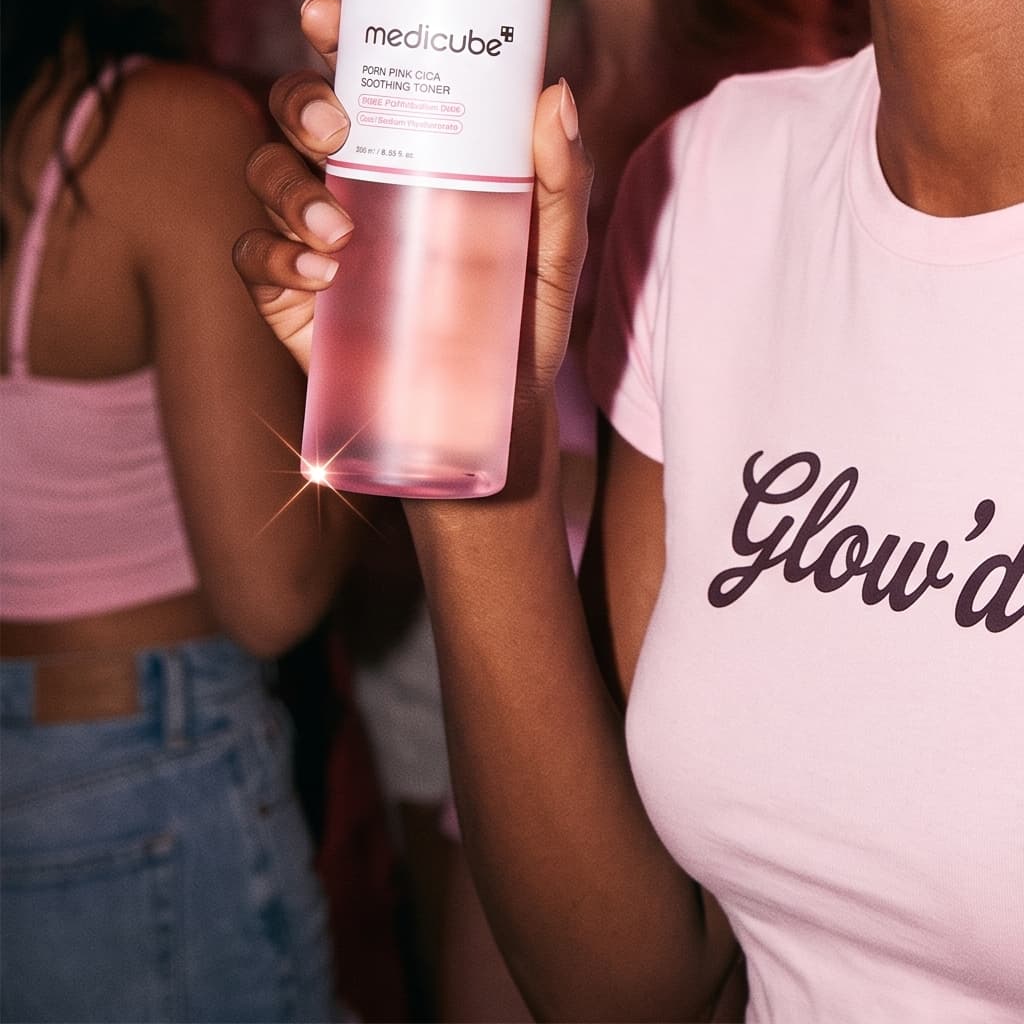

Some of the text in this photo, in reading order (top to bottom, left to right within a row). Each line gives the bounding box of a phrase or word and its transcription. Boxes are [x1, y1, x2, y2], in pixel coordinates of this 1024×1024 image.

[365, 24, 502, 57] medicube
[362, 65, 441, 82] PORN PINK CICA
[361, 77, 451, 95] SOOTHING TONER
